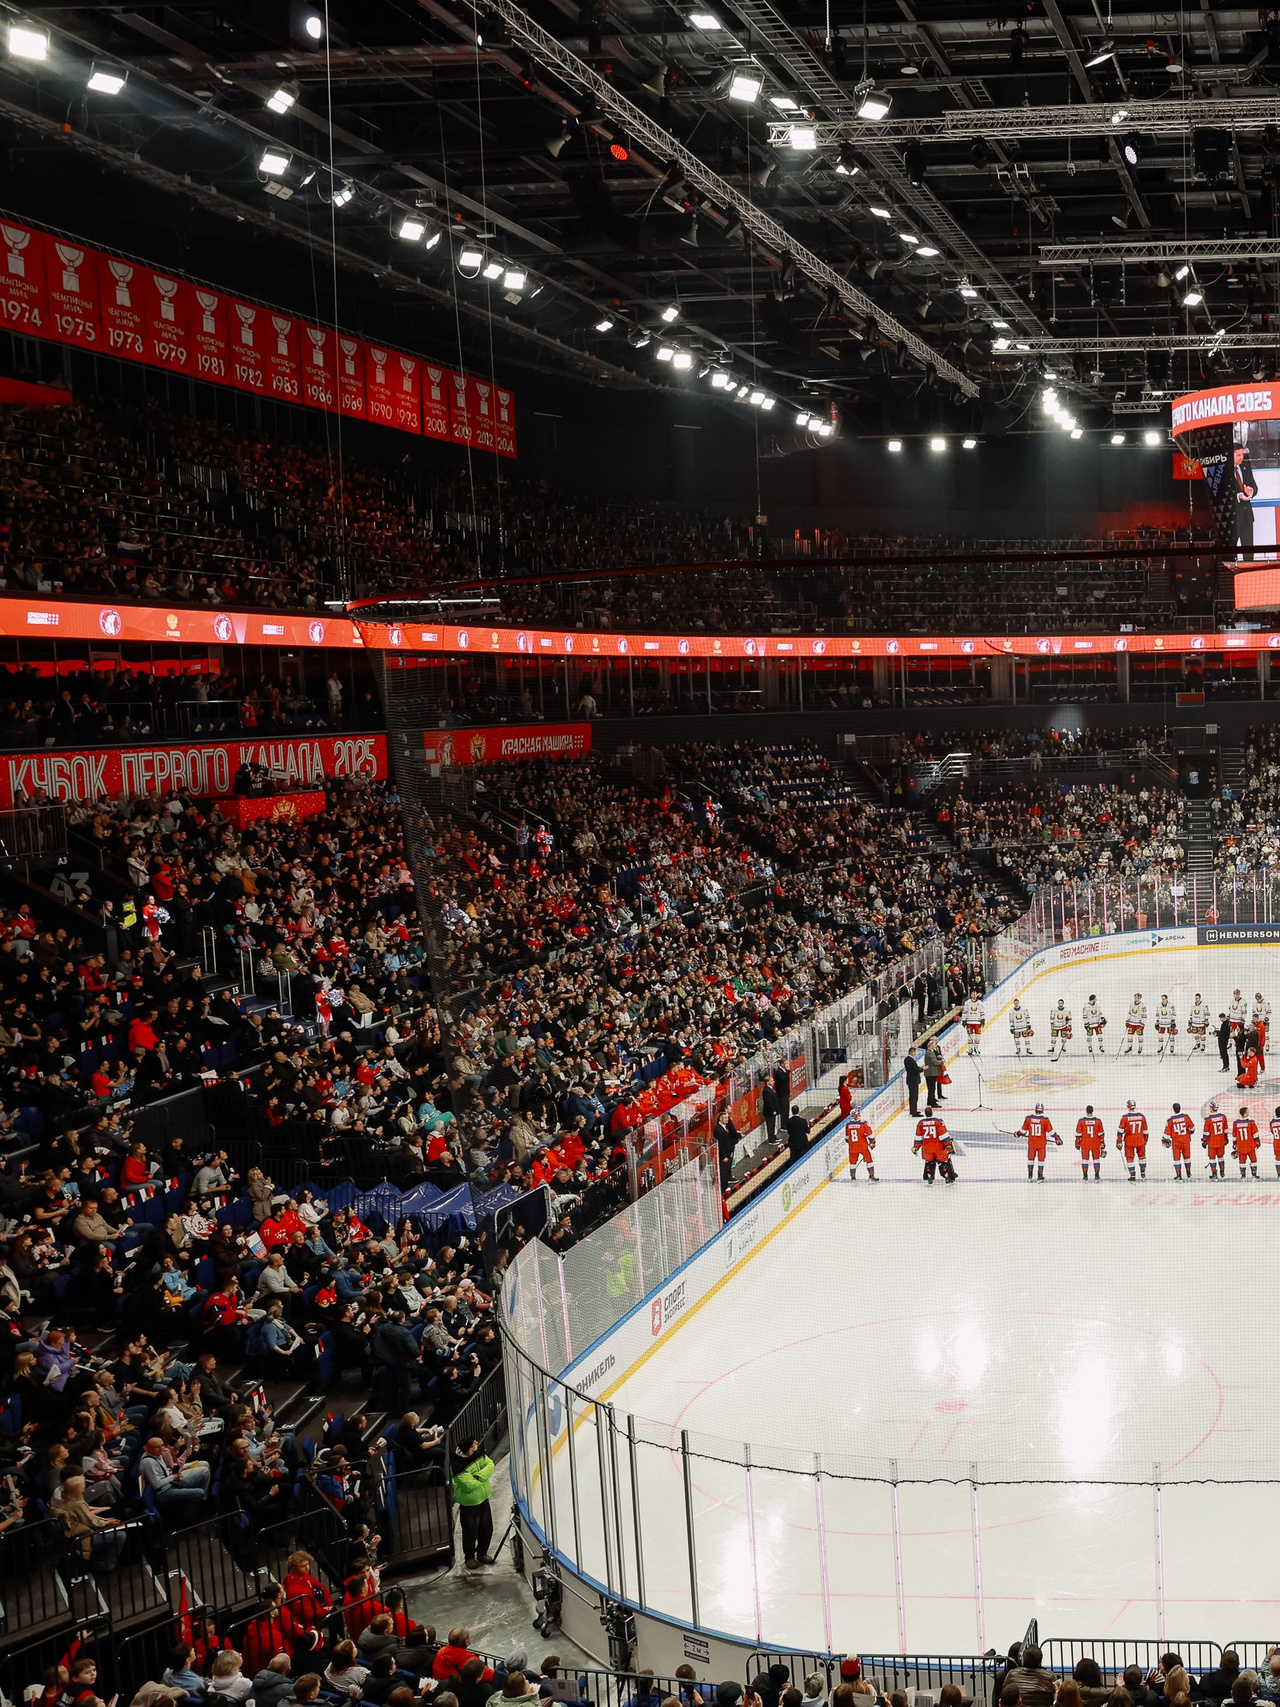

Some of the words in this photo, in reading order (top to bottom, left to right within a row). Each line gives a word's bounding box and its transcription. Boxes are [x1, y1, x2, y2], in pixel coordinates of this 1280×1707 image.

[52, 292, 93, 310] ЧЕМПИОНЫ
[0, 298, 42, 328] 1974
[55, 313, 96, 342] 1975
[108, 327, 144, 354] 1978
[154, 340, 186, 365] 1979
[198, 354, 224, 376] 1981
[235, 364, 264, 387] 1982
[272, 374, 298, 396] 1983
[306, 384, 332, 405] 1986
[342, 393, 362, 412] 1989
[370, 401, 392, 420] 1990
[1193, 394, 1234, 419] КАНАЛА
[1236, 391, 1272, 413] 2025
[396, 408, 418, 428] 1993
[1200, 454, 1227, 466] ИБИРЬ
[1212, 464, 1225, 496] АРЕНА
[502, 736, 542, 755] КРАСНАЯ
[542, 735, 574, 750] МАШИНА
[8, 754, 108, 803] КУБОК
[121, 748, 229, 800] ПЕРВОГО
[240, 741, 324, 784] КАНАЛА
[334, 739, 377, 779] 2025
[1220, 930, 1280, 940] HENDERSON
[1060, 948, 1072, 960] RED
[1071, 942, 1100, 957] MACHINE
[232, 986, 240, 994] 13
[850, 1130, 858, 1142] 8
[922, 1126, 937, 1139] 29
[1031, 1124, 1042, 1136] 10
[1086, 1126, 1094, 1138] 4
[1129, 1121, 1142, 1134] 77
[1173, 1122, 1187, 1136] 45
[1213, 1122, 1223, 1135] 13
[1238, 1128, 1248, 1140] 11
[664, 1280, 686, 1312] СПОРТ
[664, 1297, 686, 1323] ЭКСПРЕСС
